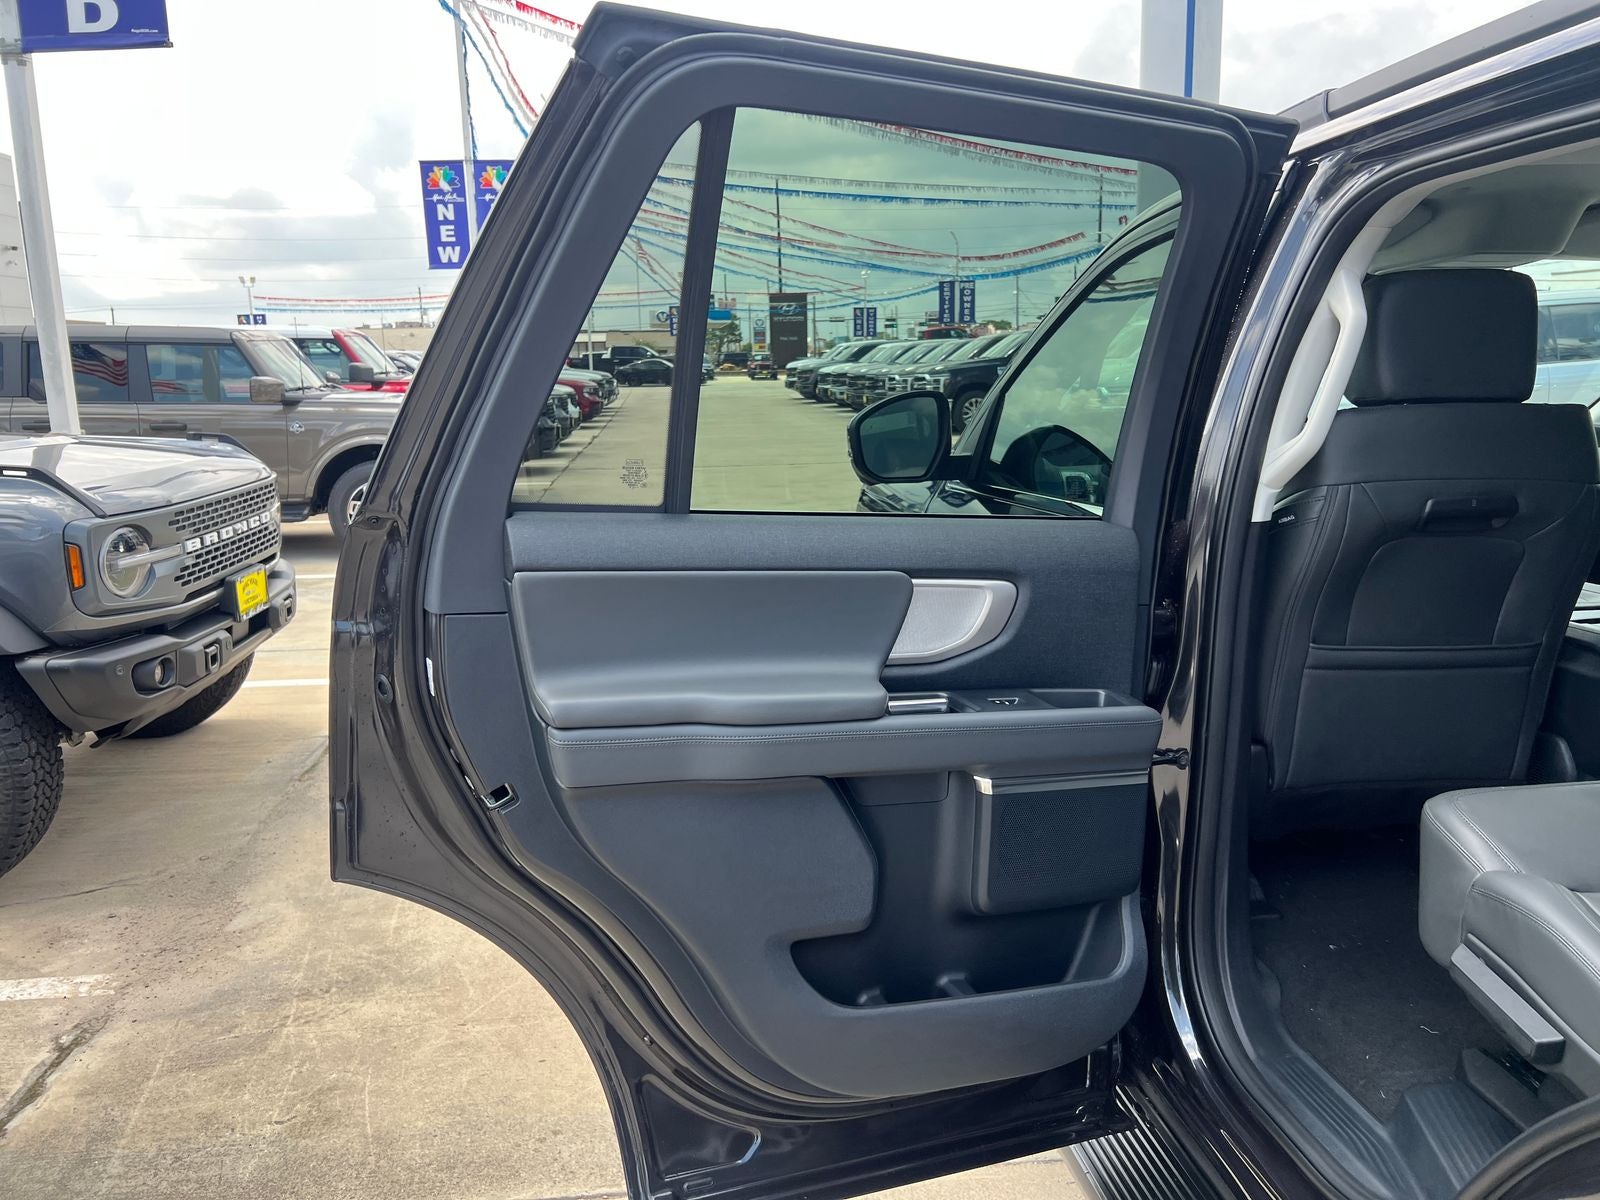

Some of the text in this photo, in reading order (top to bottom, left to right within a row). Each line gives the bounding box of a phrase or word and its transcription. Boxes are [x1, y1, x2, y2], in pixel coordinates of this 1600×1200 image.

[66, 0, 119, 34] D
[436, 203, 461, 263] NEW
[943, 282, 951, 323] CERTIFIED
[963, 289, 972, 321] OWNED
[185, 511, 271, 553] BRONCO
